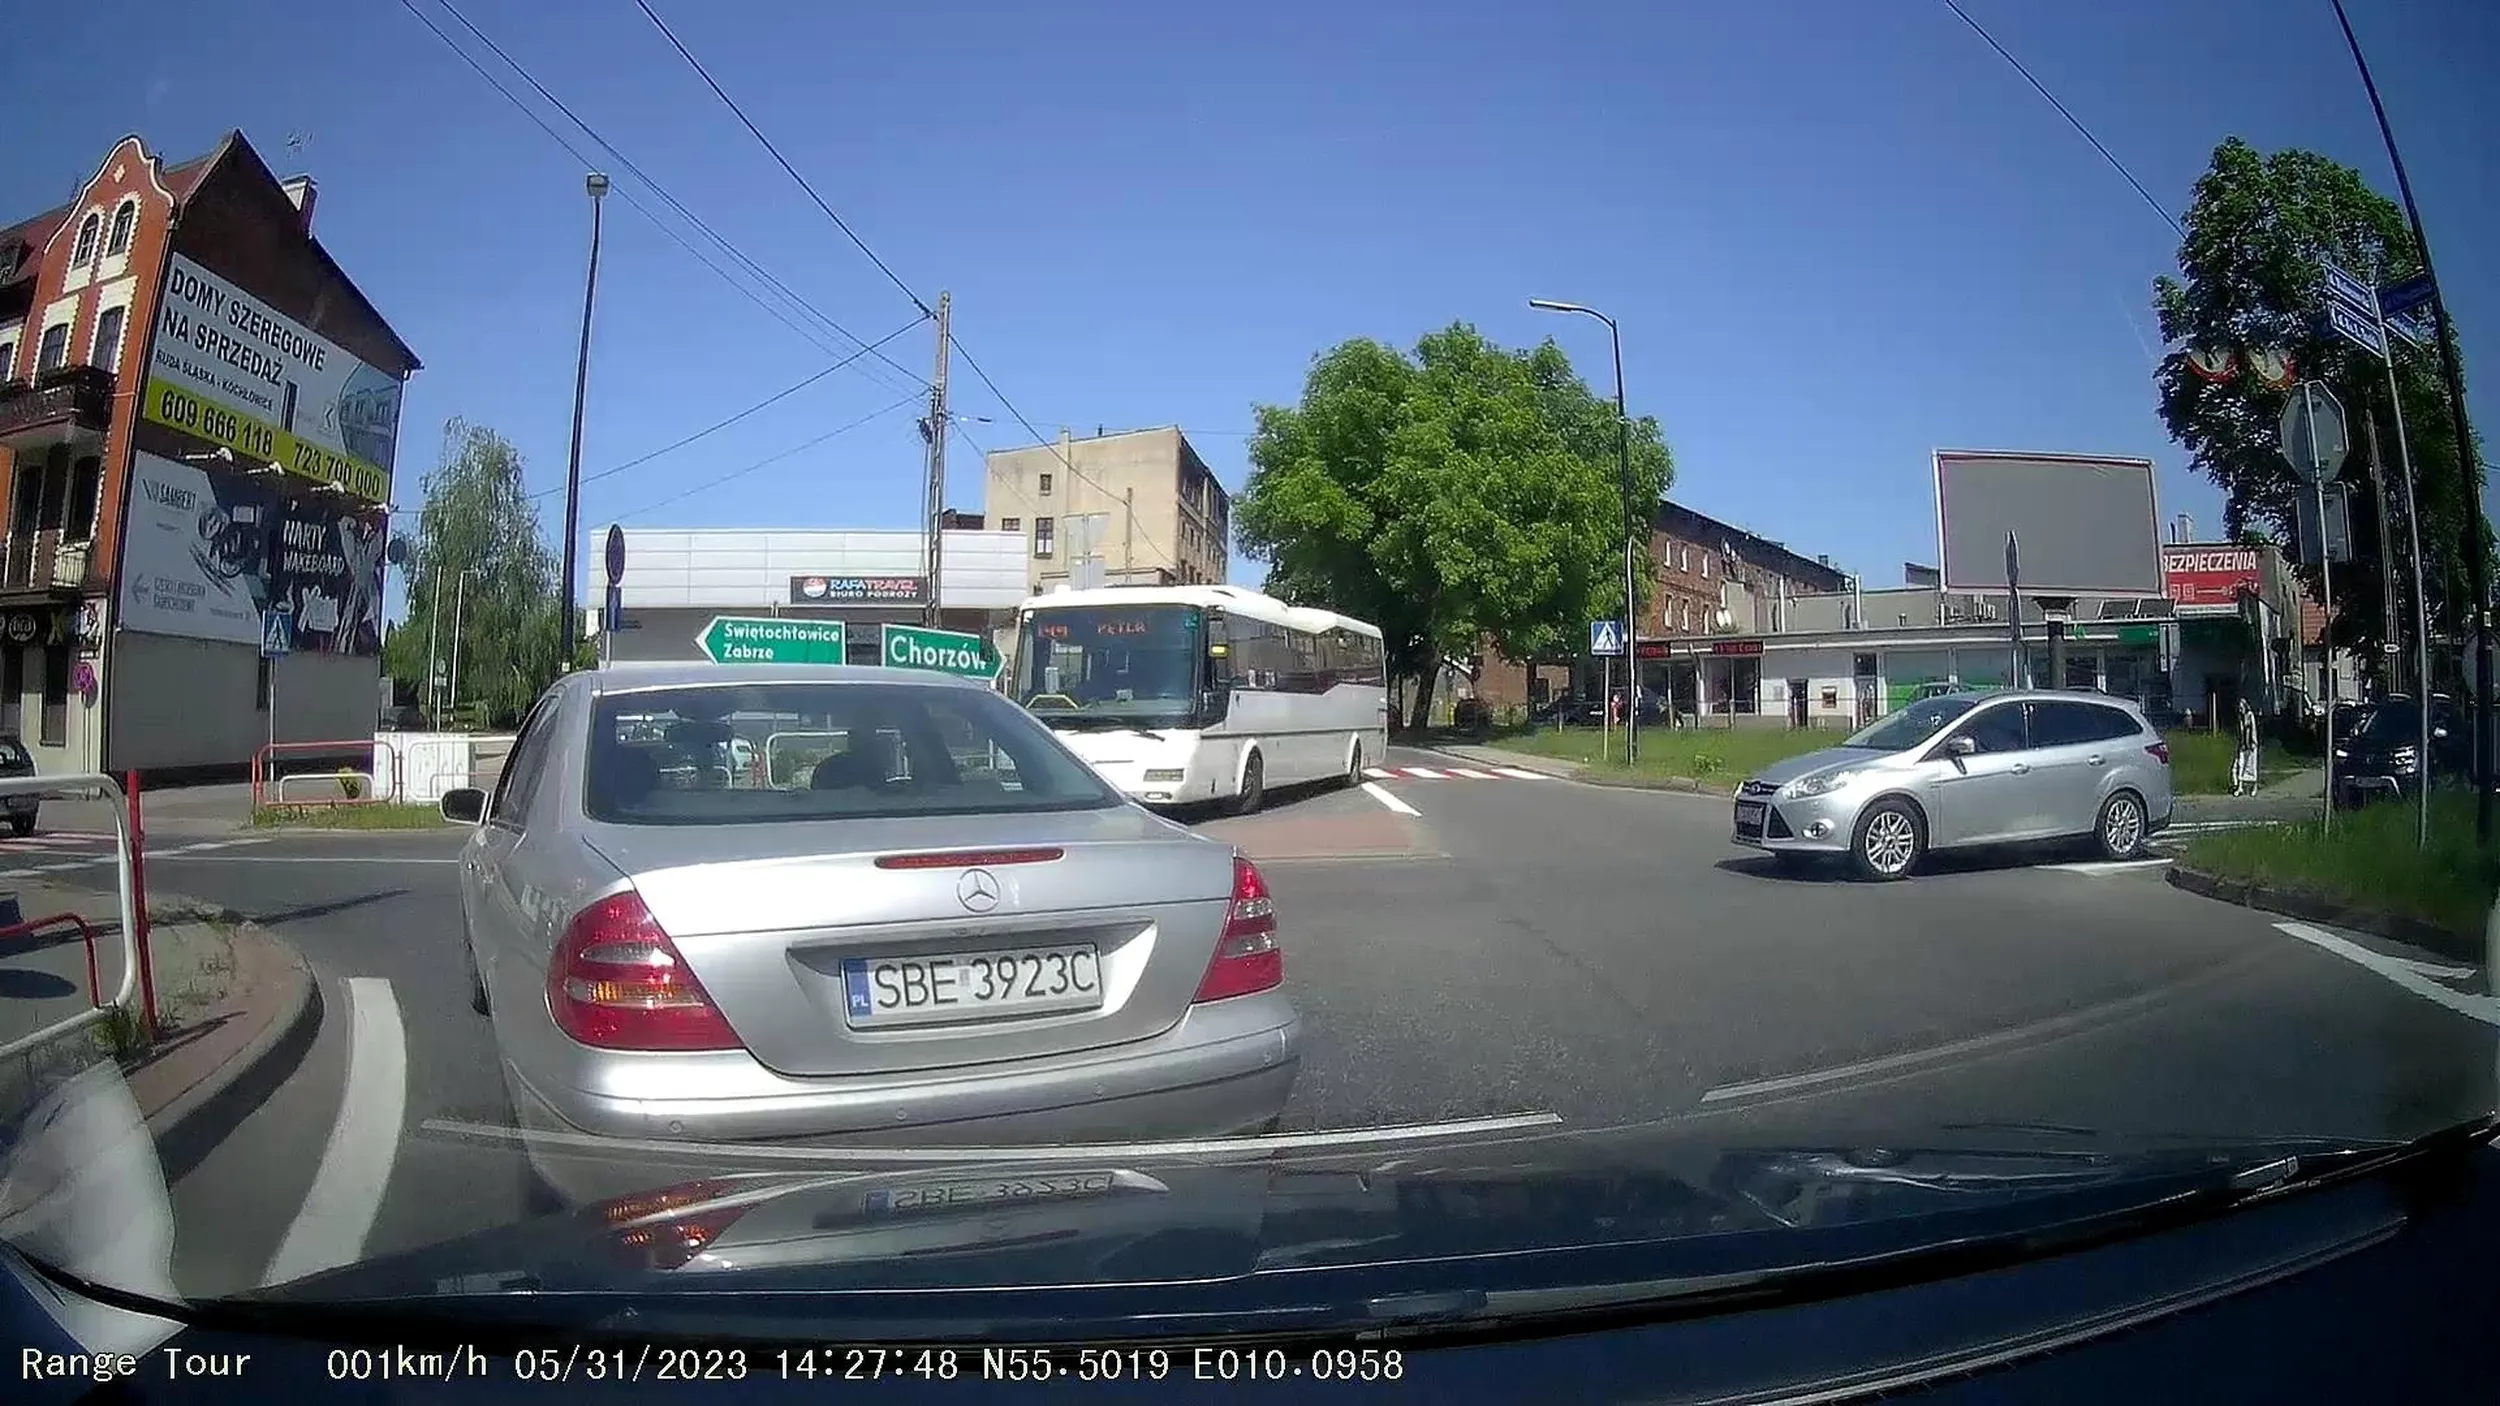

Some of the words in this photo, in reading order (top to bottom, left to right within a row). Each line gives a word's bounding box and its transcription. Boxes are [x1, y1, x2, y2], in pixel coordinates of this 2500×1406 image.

[170, 268, 226, 317] DOMY
[228, 301, 327, 372] SZEREGOWE
[156, 349, 181, 371] RUDA
[161, 307, 190, 343] NA
[194, 324, 285, 388] SPRZEDAŻ
[161, 390, 198, 428] 609
[203, 407, 237, 443] 666
[242, 422, 273, 457] 118
[294, 442, 322, 475] 723
[326, 456, 351, 485] 700
[355, 467, 380, 497] 000
[283, 520, 327, 550] NARTY
[283, 551, 345, 577] WAKEBOARD
[830, 590, 864, 599] BIURO
[723, 643, 774, 660] Zabrze
[890, 635, 987, 670] Chorzów
[875, 960, 958, 1009] SBE
[971, 950, 1095, 1001] 3923C
[852, 994, 869, 1008] PL
